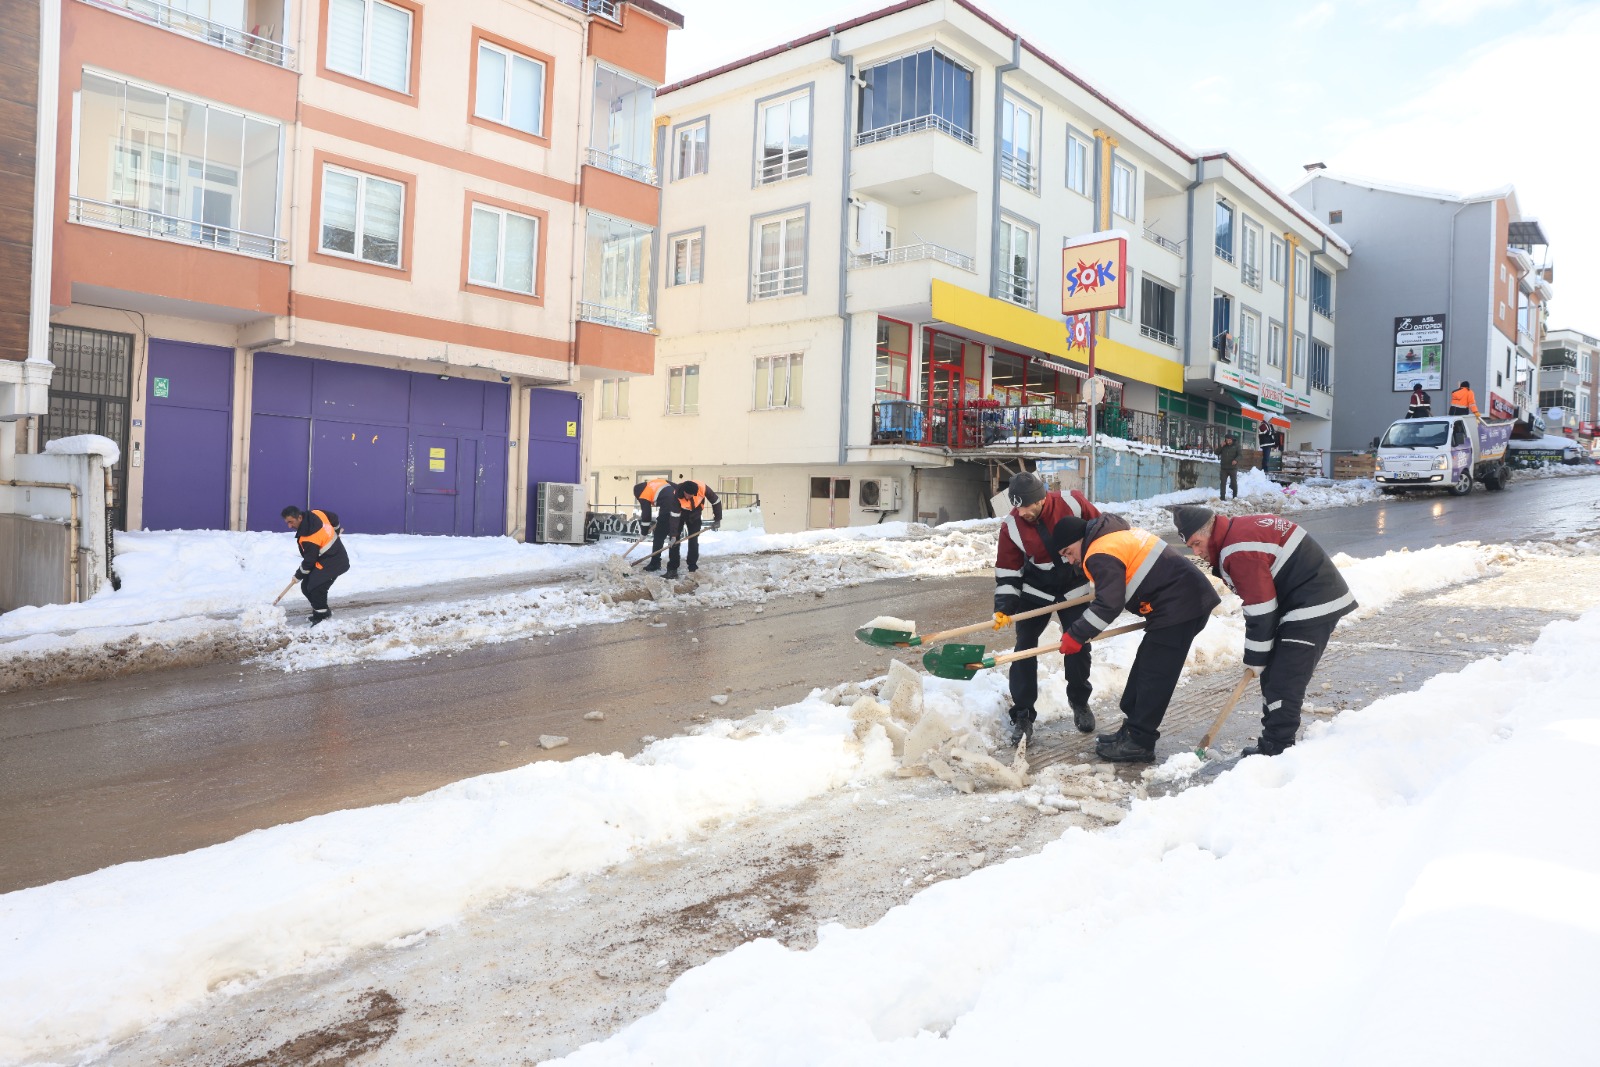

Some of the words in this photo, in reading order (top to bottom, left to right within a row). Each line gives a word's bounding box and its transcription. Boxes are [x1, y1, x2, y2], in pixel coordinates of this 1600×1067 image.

[1066, 260, 1116, 297] ŞOK
[1413, 322, 1442, 330] ORTOPEDİ
[603, 517, 646, 534] ROYA
